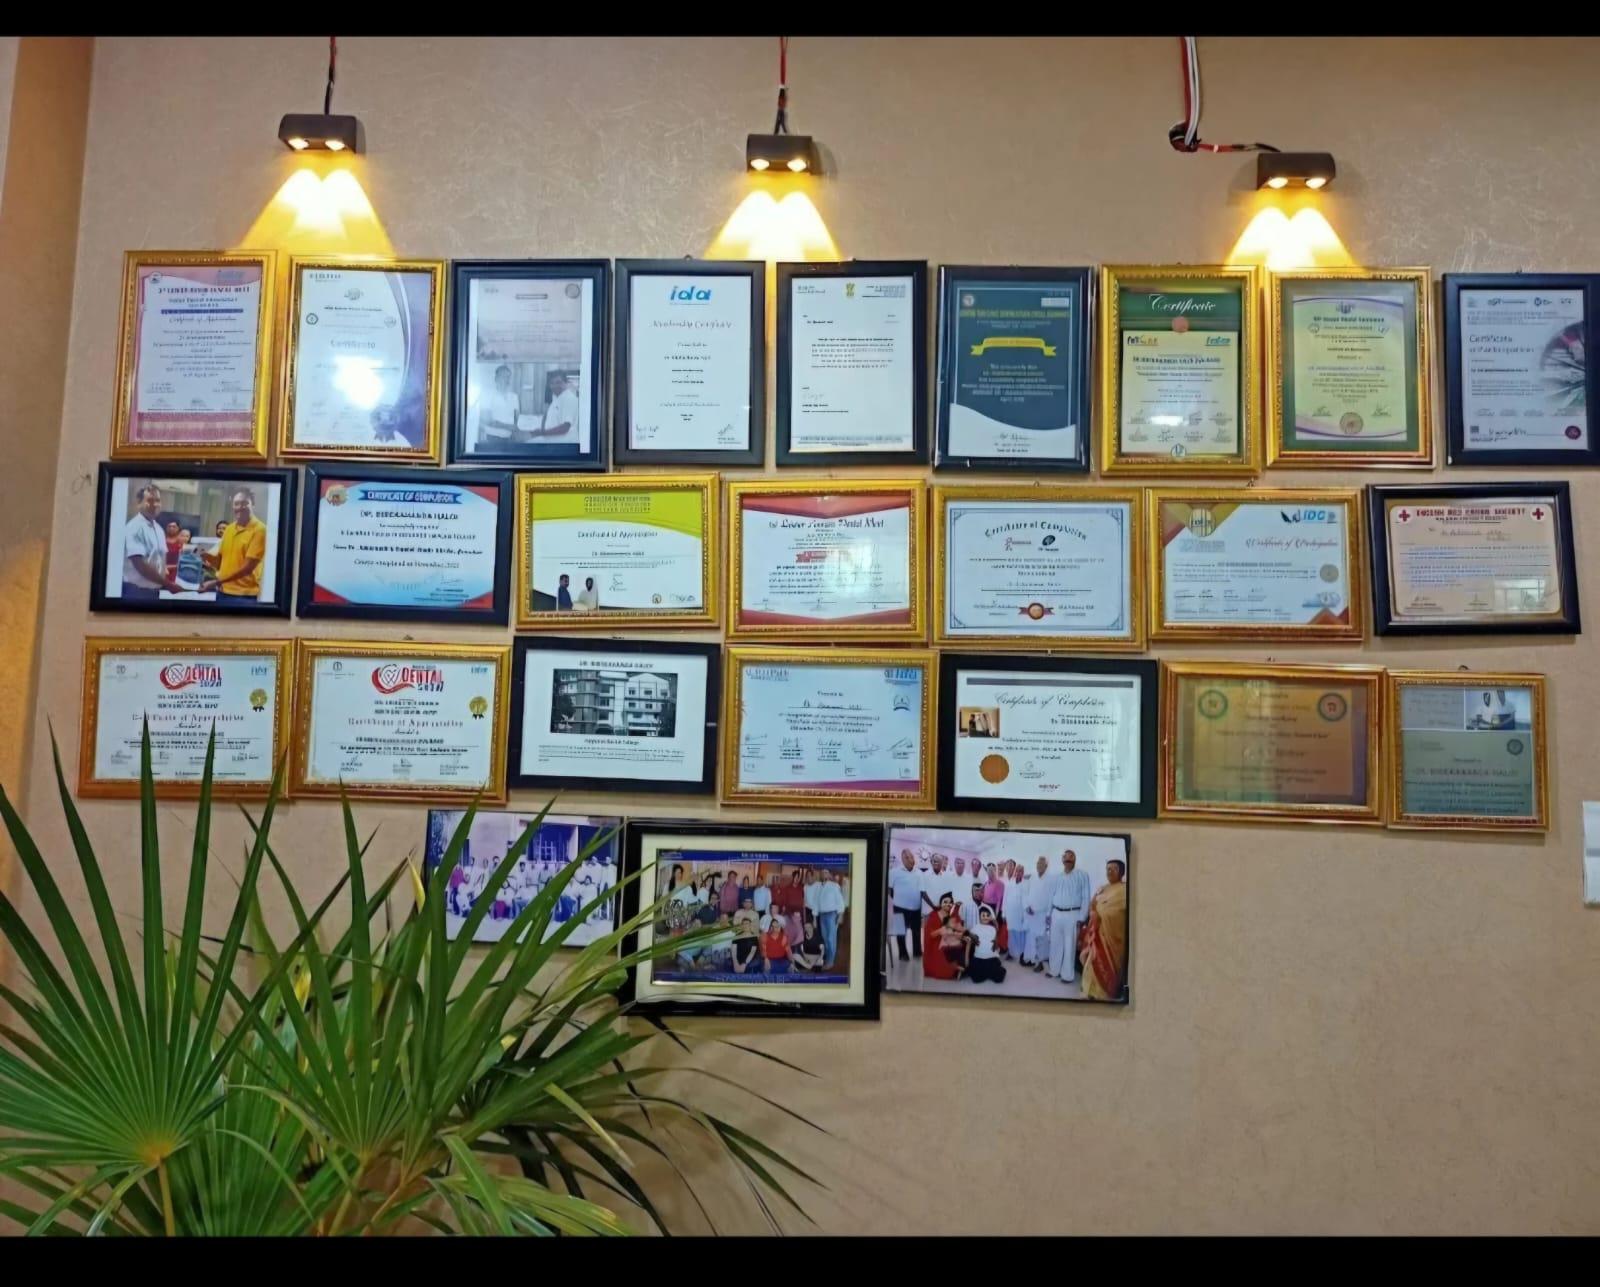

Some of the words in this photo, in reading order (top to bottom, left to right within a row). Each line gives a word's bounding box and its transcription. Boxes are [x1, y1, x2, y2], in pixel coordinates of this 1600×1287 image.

[670, 285, 712, 301] ida
[1149, 293, 1216, 315] Certificate
[1303, 509, 1326, 521] IDC
[401, 666, 444, 684] DENTAL
